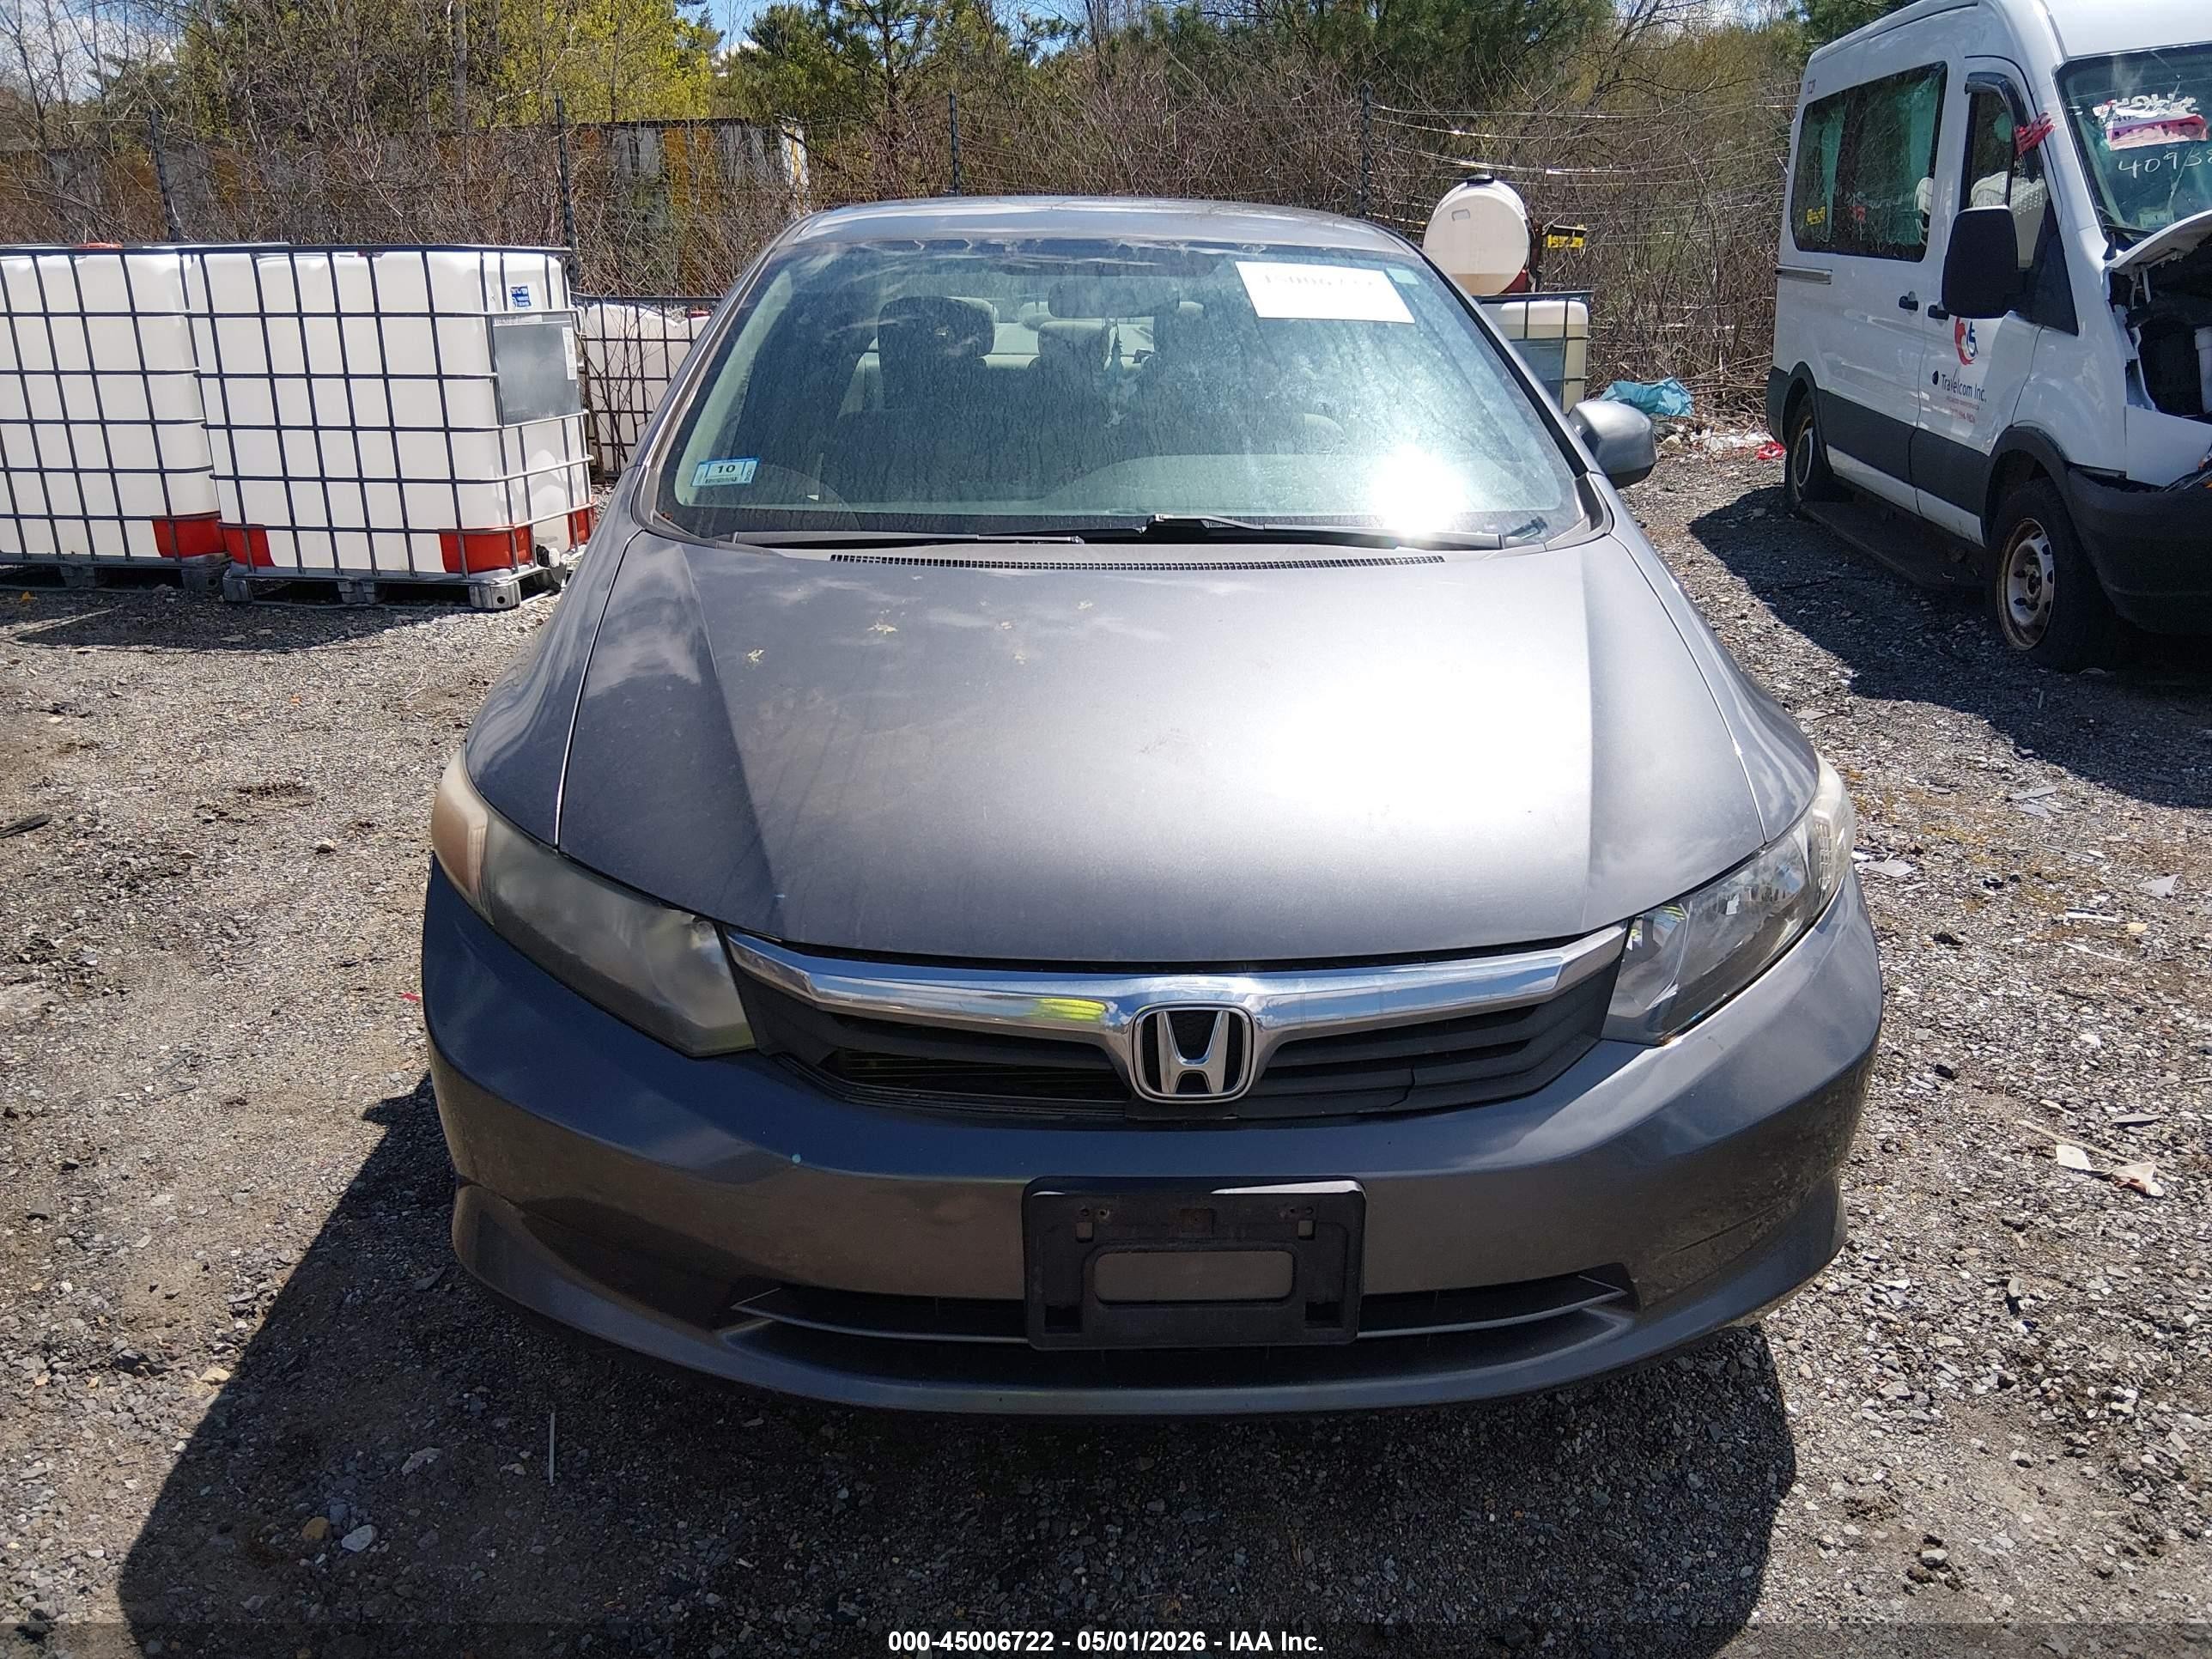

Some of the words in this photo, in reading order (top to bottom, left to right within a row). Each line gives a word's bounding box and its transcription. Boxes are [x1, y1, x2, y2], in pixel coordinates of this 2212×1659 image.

[1942, 369, 1973, 398] Travelcom
[1974, 383, 1987, 403] Inc.
[718, 465, 735, 474] 10
